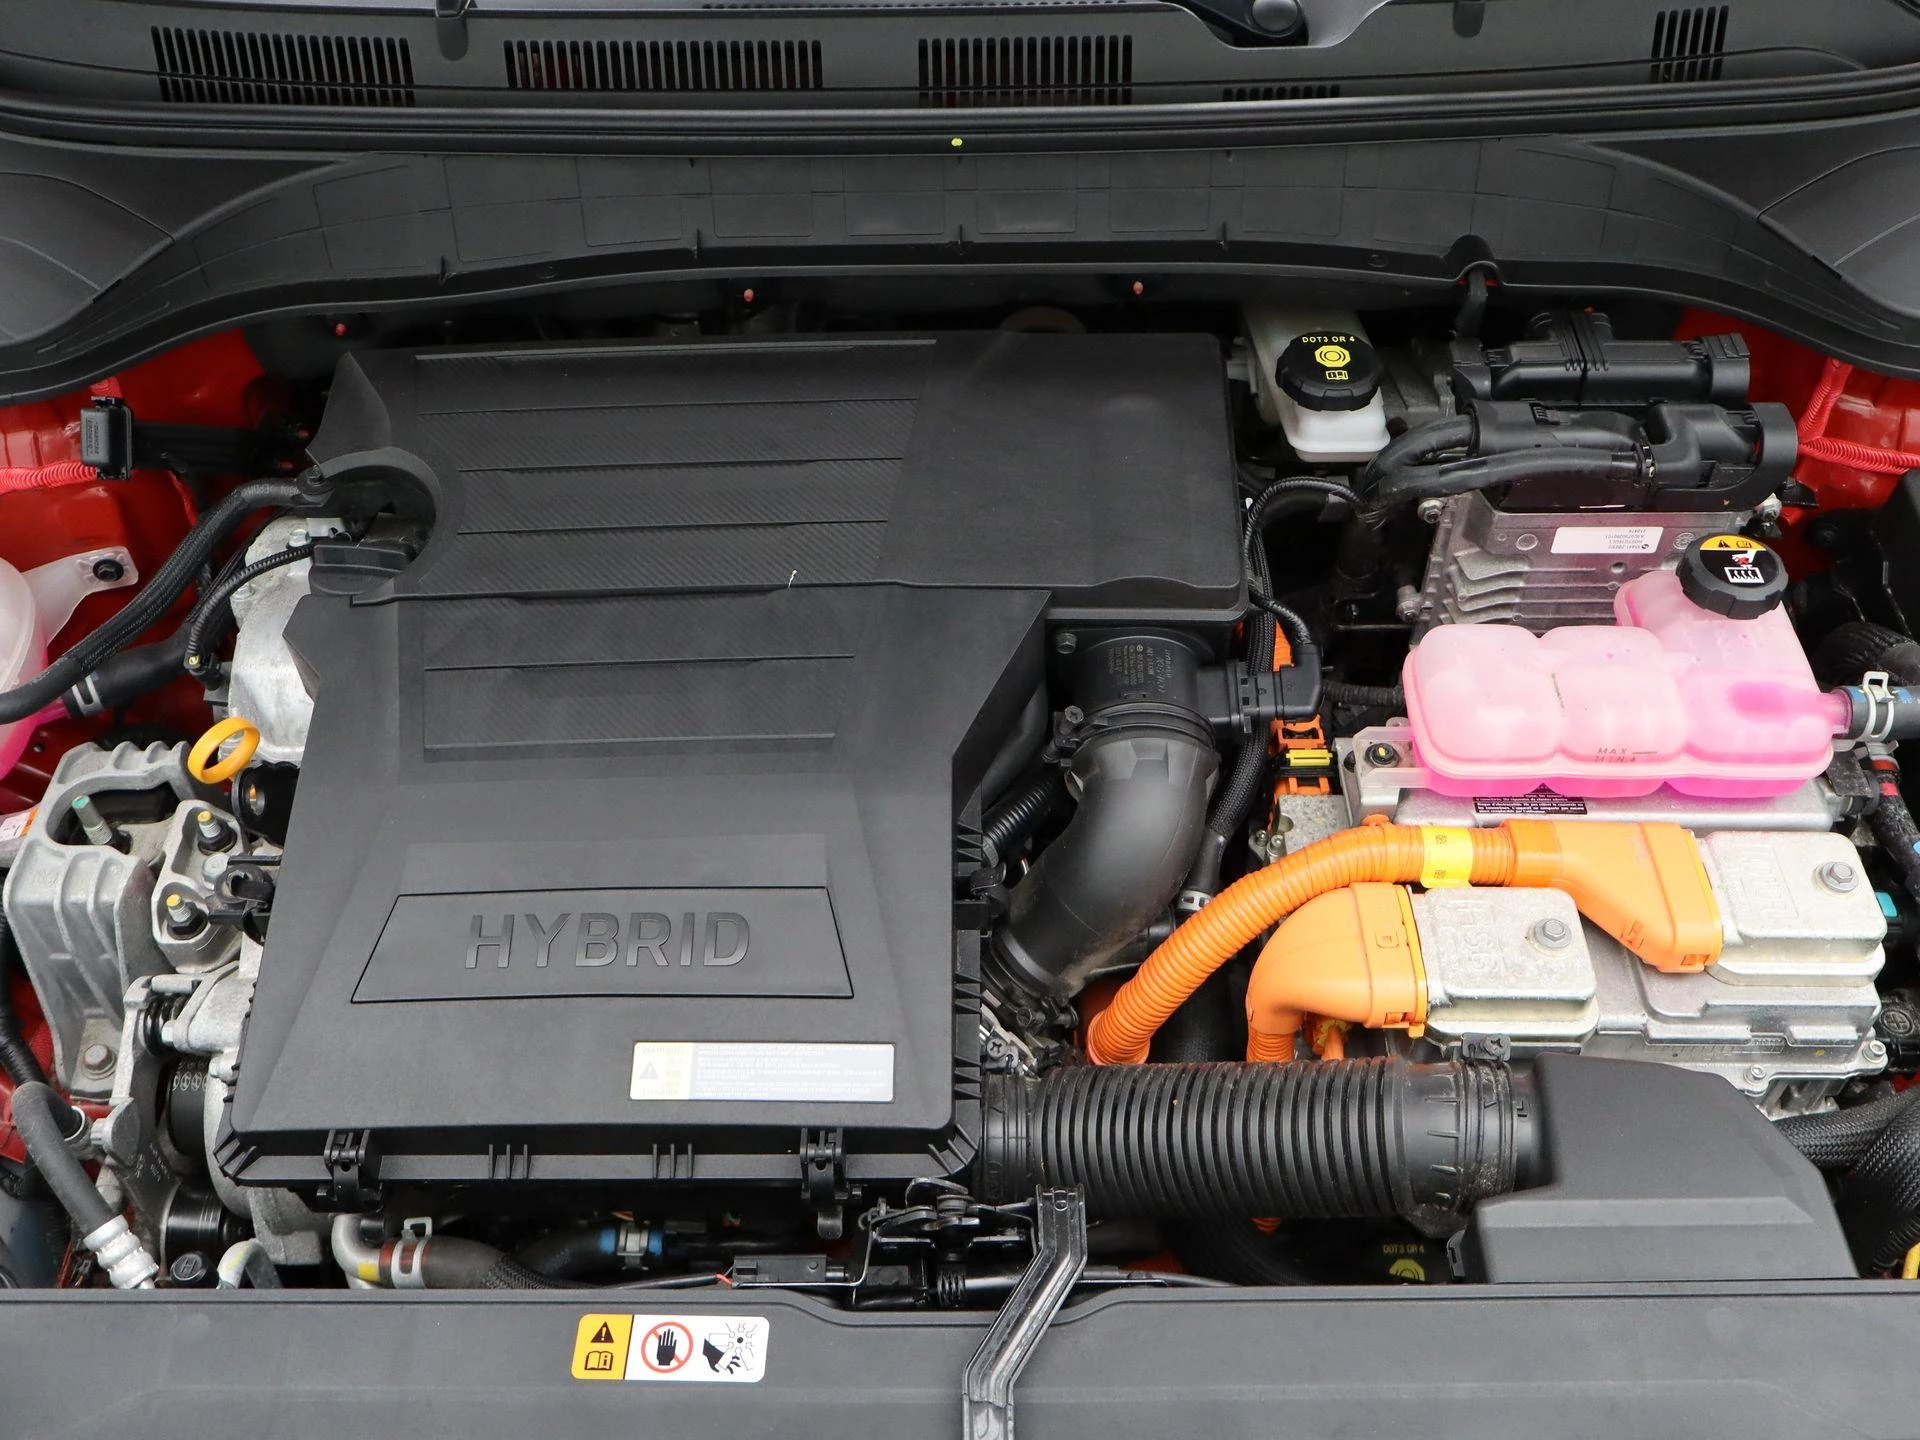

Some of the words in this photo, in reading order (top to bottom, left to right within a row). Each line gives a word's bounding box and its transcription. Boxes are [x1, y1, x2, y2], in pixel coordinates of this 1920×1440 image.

[1597, 747, 1628, 755] MAX
[464, 912, 751, 969] HYBRID
[1406, 1244, 1418, 1254] OR
[1419, 1244, 1425, 1254] 4
